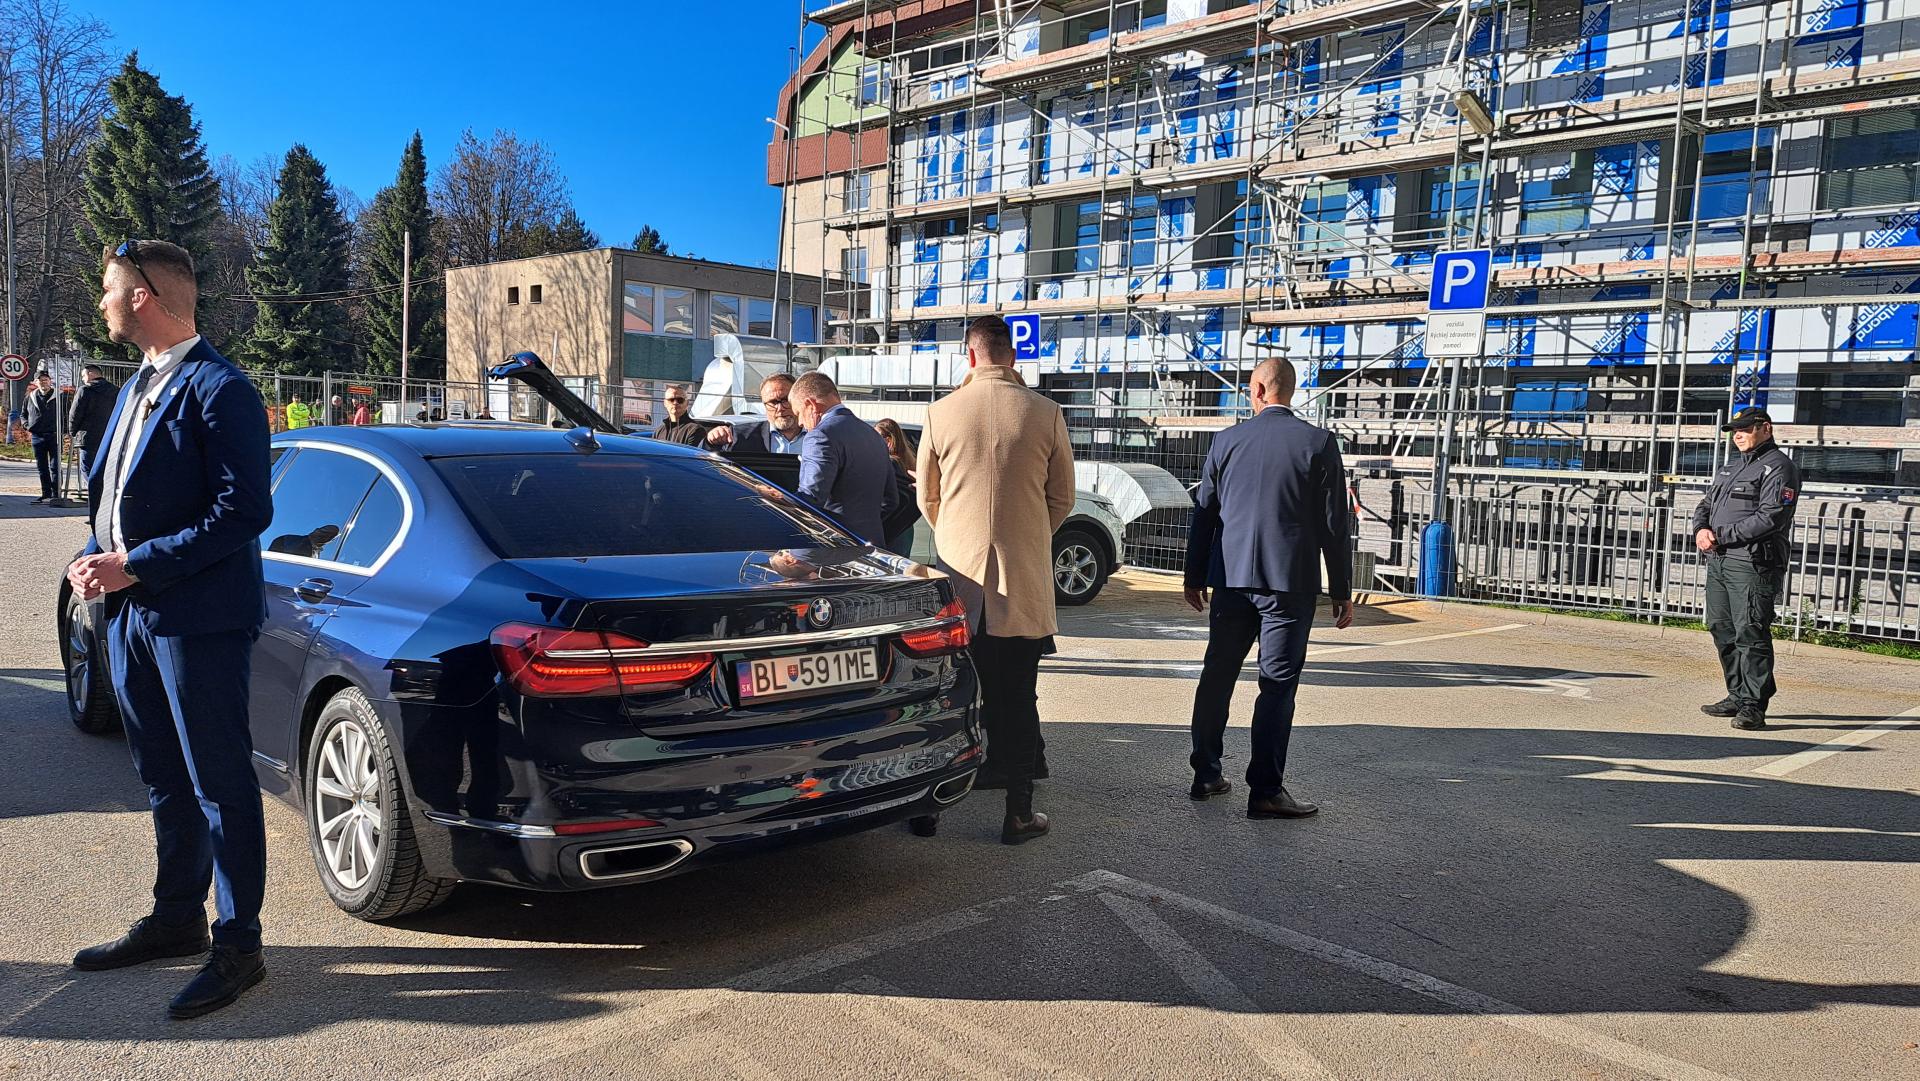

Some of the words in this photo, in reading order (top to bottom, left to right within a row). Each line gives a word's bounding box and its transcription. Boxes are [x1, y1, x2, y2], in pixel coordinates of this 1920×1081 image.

[1443, 258, 1476, 303] P
[1012, 320, 1032, 349] P
[5, 361, 21, 372] 30
